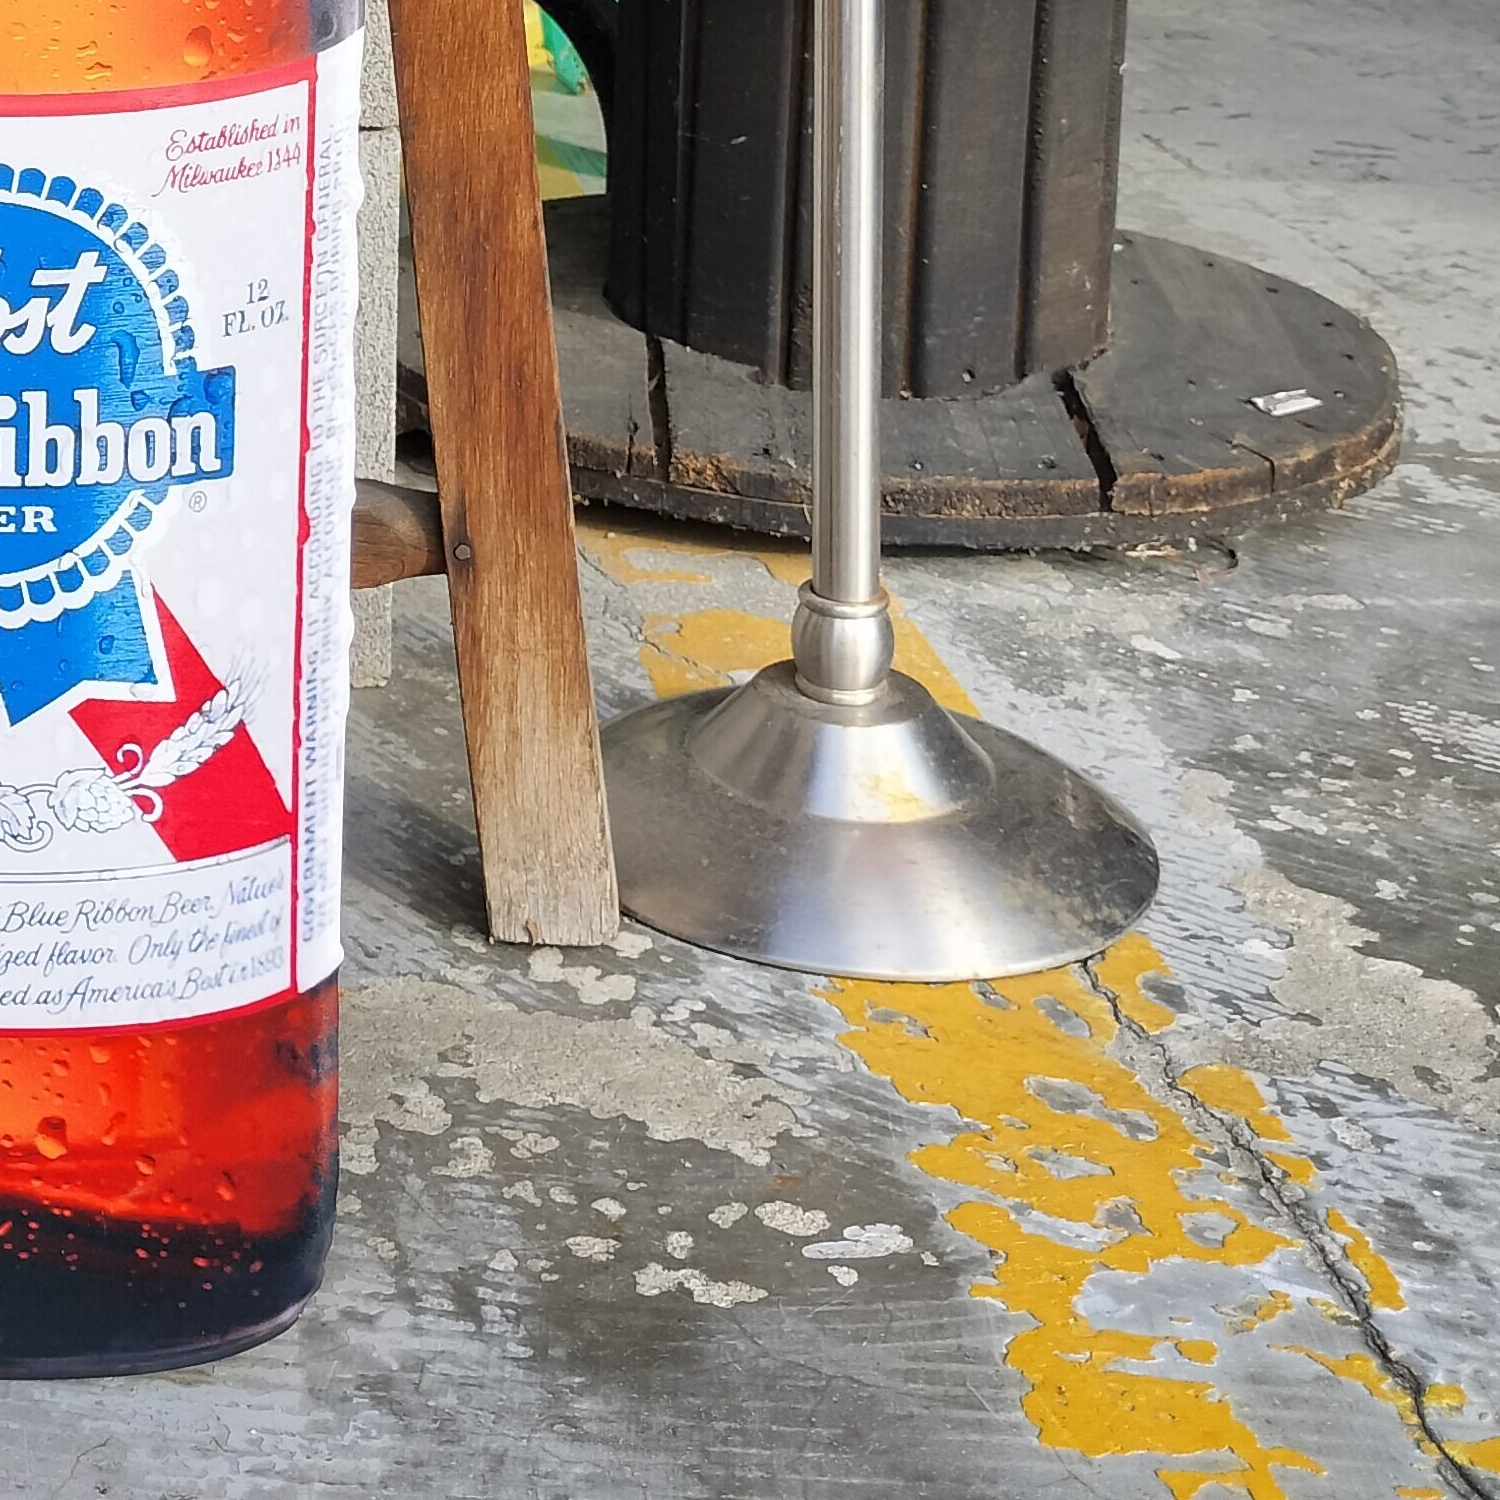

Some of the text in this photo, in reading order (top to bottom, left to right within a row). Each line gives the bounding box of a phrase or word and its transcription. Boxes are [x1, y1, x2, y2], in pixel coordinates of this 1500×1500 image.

[166, 114, 301, 161] Established in
[151, 157, 263, 198] Milwaukee
[266, 142, 301, 174] 1844
[246, 278, 270, 305] 12
[222, 309, 256, 338] FL.
[312, 375, 326, 413] THE
[311, 424, 325, 451] TO
[308, 461, 324, 599] ACCORDING
[61, 899, 154, 933] Ribbon
[128, 930, 185, 966] Only
[186, 925, 220, 954] the
[35, 986, 62, 1006] as
[46, 974, 177, 1016] America's
[176, 963, 228, 1002] Best
